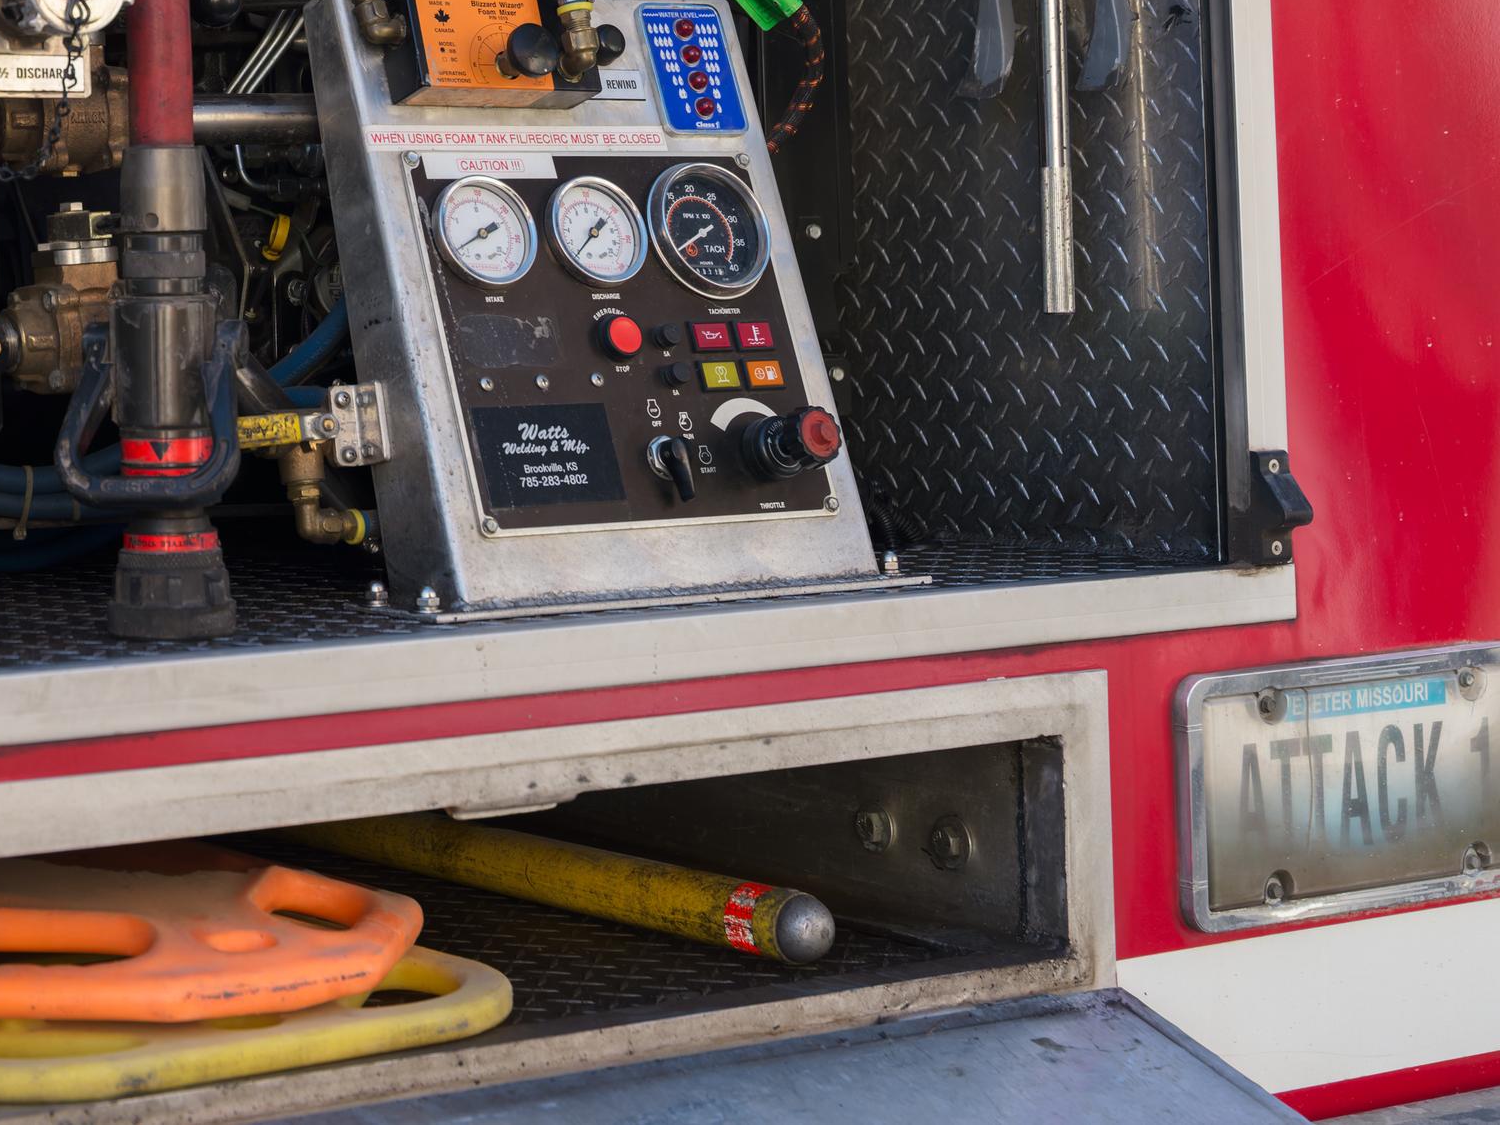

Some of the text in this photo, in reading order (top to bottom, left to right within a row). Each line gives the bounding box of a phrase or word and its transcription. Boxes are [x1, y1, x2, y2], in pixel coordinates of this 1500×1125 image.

[470, 0, 497, 8] Blizzard
[477, 8, 517, 17] Foam Mixer
[16, 67, 74, 80] DISCHAR
[605, 79, 637, 90] REWIND
[371, 133, 405, 144] WHEN
[408, 133, 443, 144] USING
[445, 133, 477, 144] FOAM
[479, 133, 508, 144] TANK
[570, 134, 599, 144] MUST
[603, 134, 616, 144] BE
[619, 134, 661, 144] CLOSED
[460, 160, 509, 171] CAUTION
[684, 184, 695, 193] 20
[666, 192, 675, 201] 15
[706, 193, 717, 201] 25
[727, 215, 738, 224] 30
[735, 238, 746, 247] 35
[704, 245, 726, 253] TACH
[729, 264, 740, 272] 40
[593, 307, 627, 321] EMERGENC
[615, 365, 630, 373] STOP
[518, 422, 570, 441] Watts
[502, 439, 591, 457] Welding & Mfg.
[523, 461, 579, 474] Brookville, KS
[700, 466, 716, 474] START
[519, 473, 589, 488] 785-283-4802
[759, 501, 785, 509] THROTTLE
[1356, 682, 1429, 708] MISSOURI
[1238, 720, 1446, 847] ATTACK
